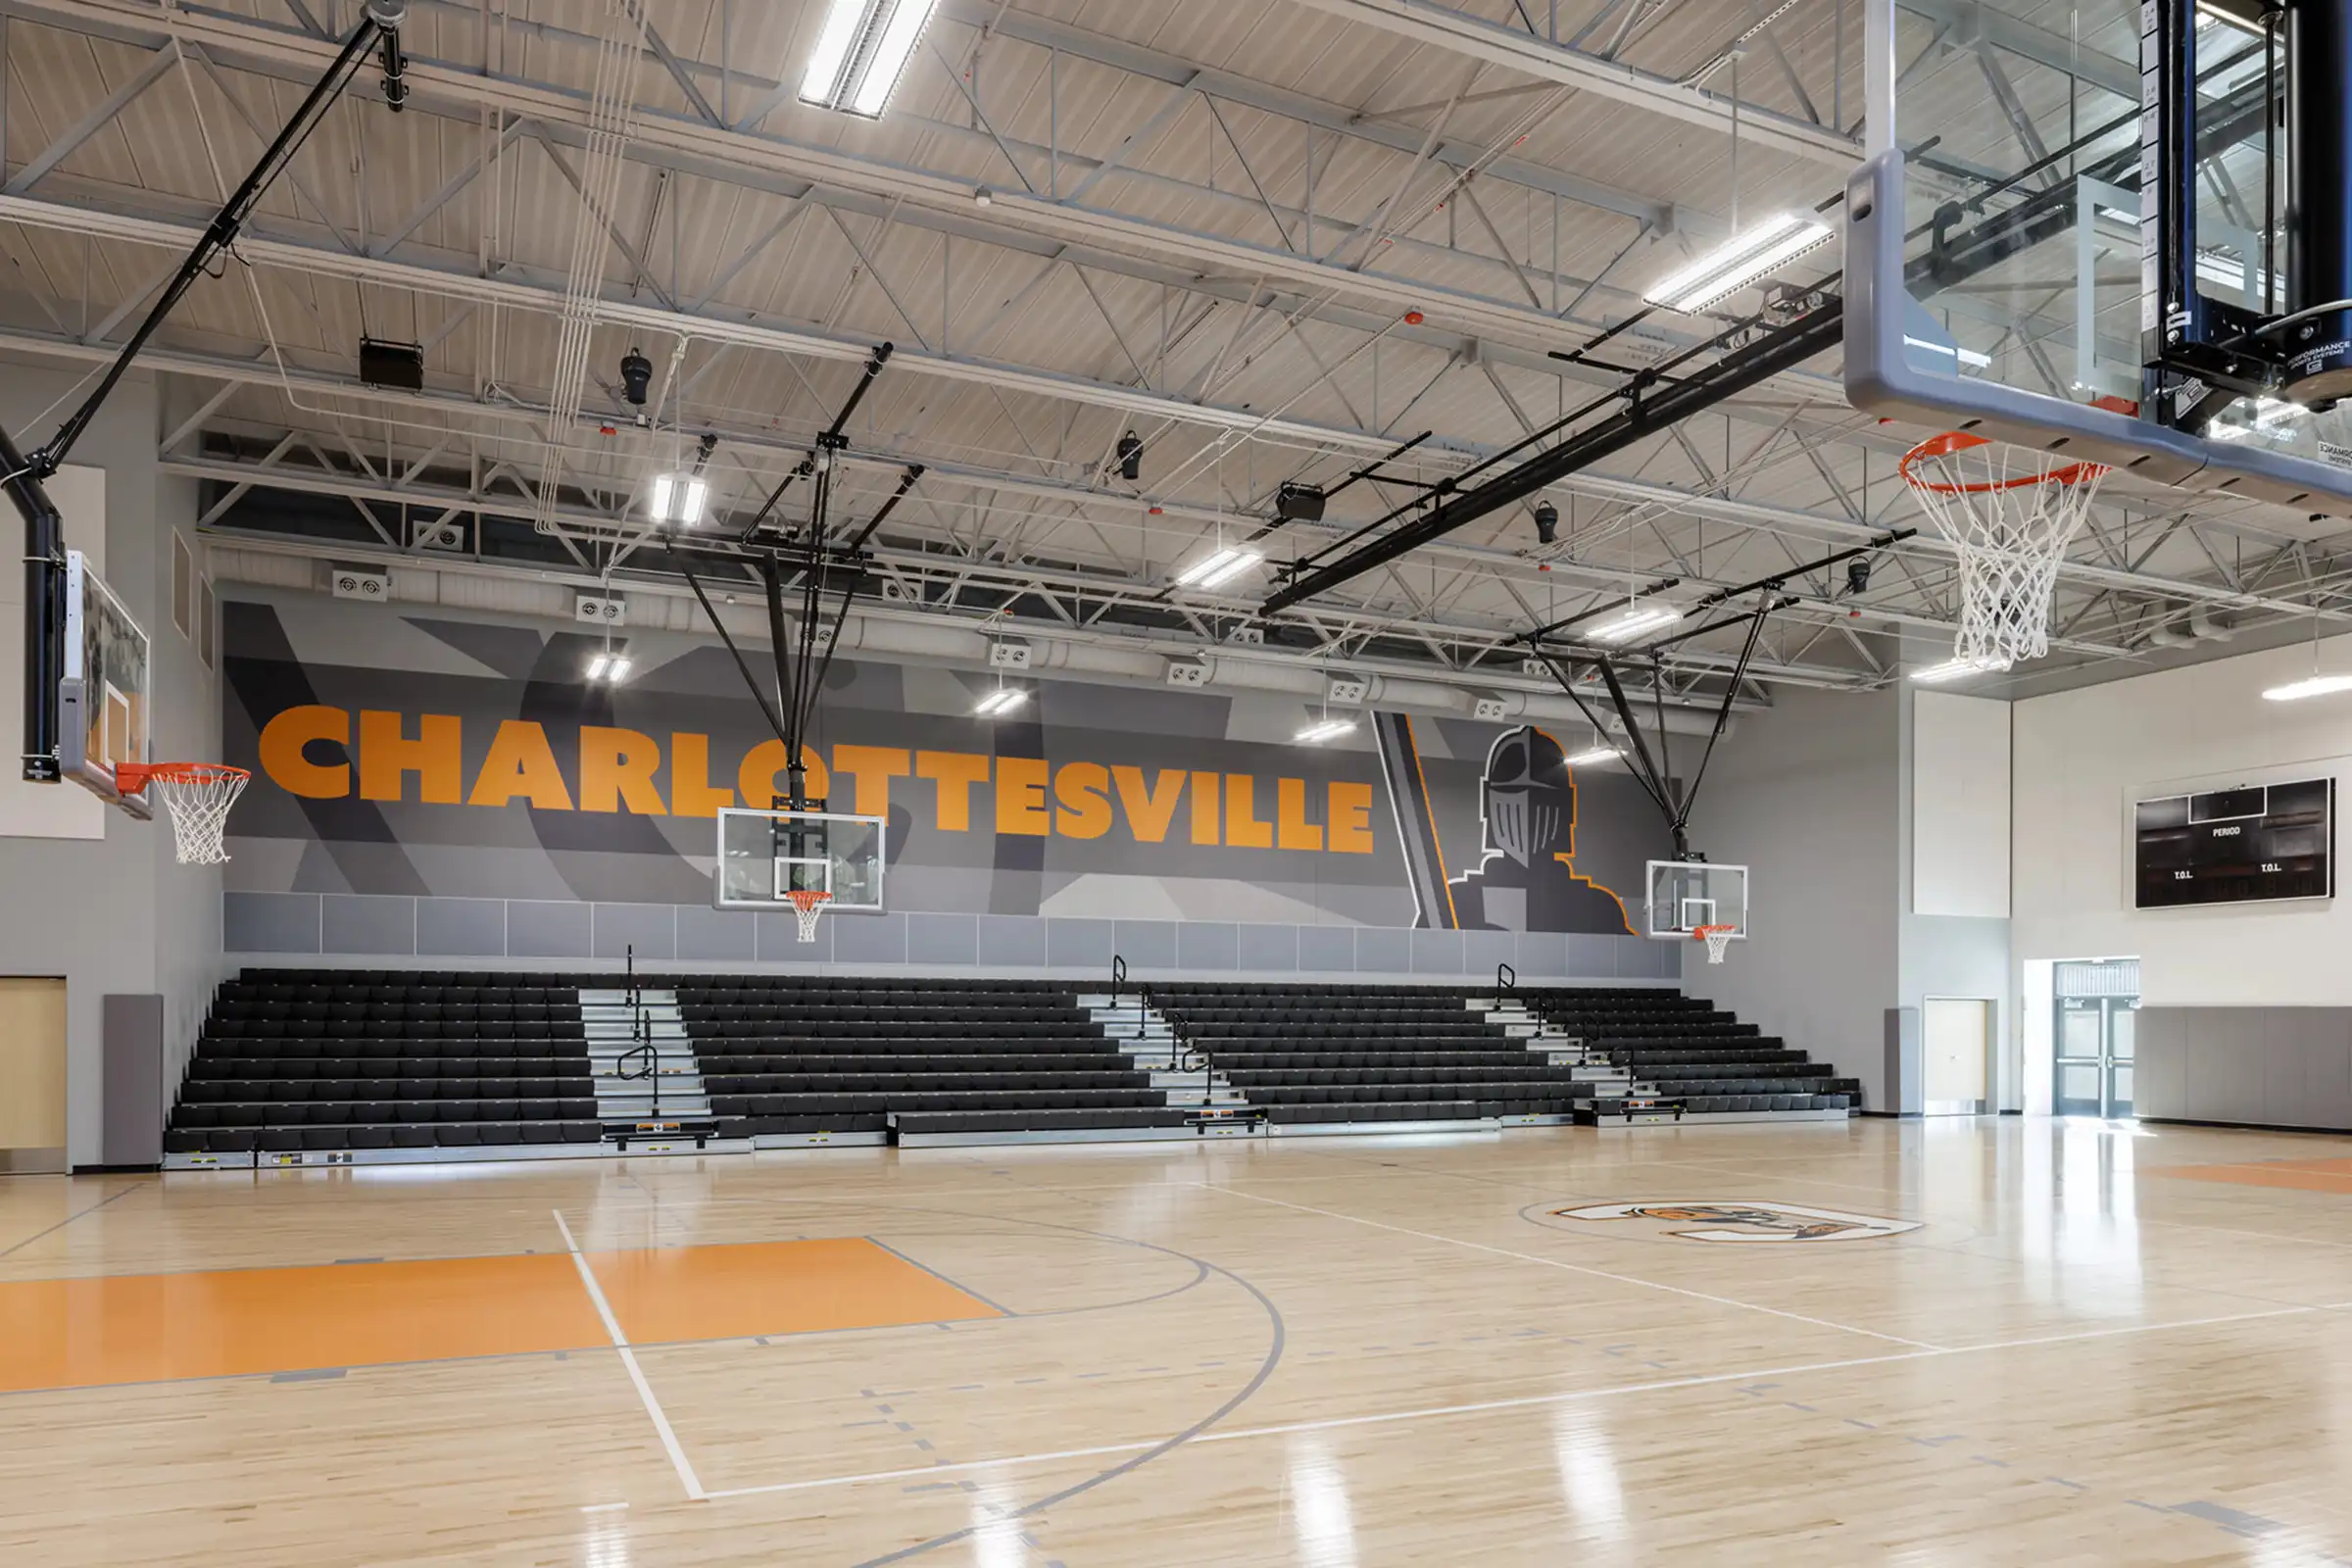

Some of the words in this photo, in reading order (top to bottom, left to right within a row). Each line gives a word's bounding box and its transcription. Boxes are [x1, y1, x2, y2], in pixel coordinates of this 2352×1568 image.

[2287, 340, 2350, 367] PERFORMANCE
[259, 704, 1374, 855] CHARLOTTESVILLE
[2213, 826, 2240, 837] PERIOD
[2261, 863, 2281, 872] T.O.L.
[2175, 870, 2193, 879] T.O.L.
